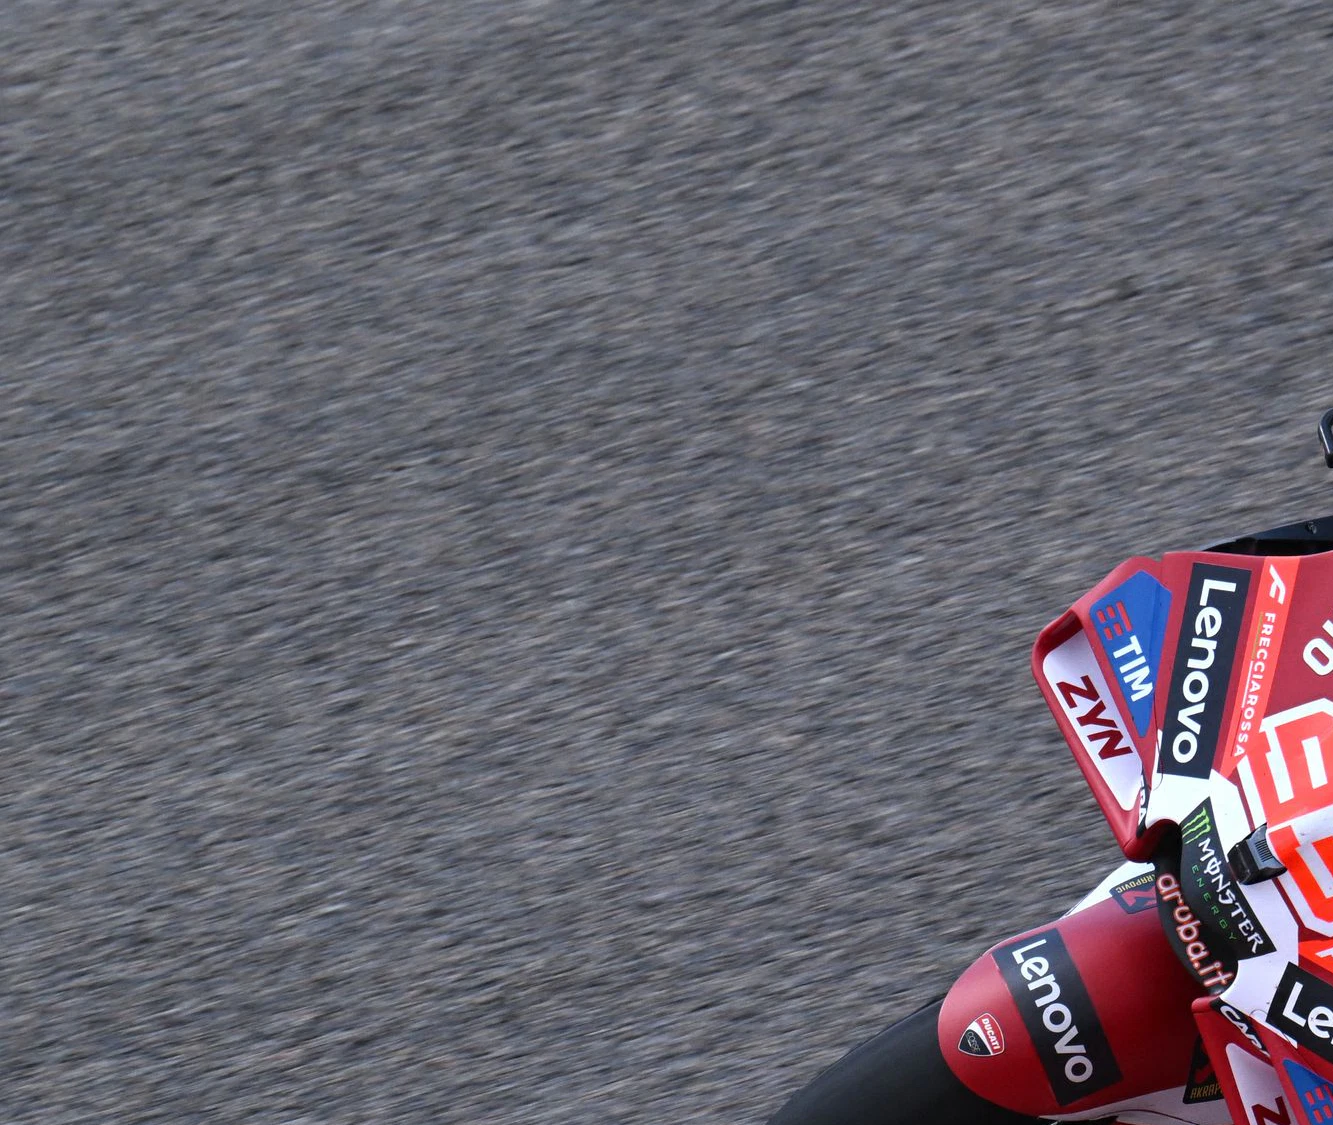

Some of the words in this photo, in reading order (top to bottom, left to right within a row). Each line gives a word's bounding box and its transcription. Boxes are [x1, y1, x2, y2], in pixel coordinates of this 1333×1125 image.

[1056, 674, 1134, 760] ZYN
[1112, 635, 1154, 702] TIM
[1172, 578, 1237, 763] Lenovo
[1233, 612, 1276, 757] FRECCIAROSSA
[1156, 873, 1234, 988] aruba.it
[1191, 864, 1237, 940] ENERGY
[1198, 837, 1264, 954] MONSTER
[981, 1018, 1001, 1050] DUCATI
[1011, 938, 1094, 1083] Lenovo
